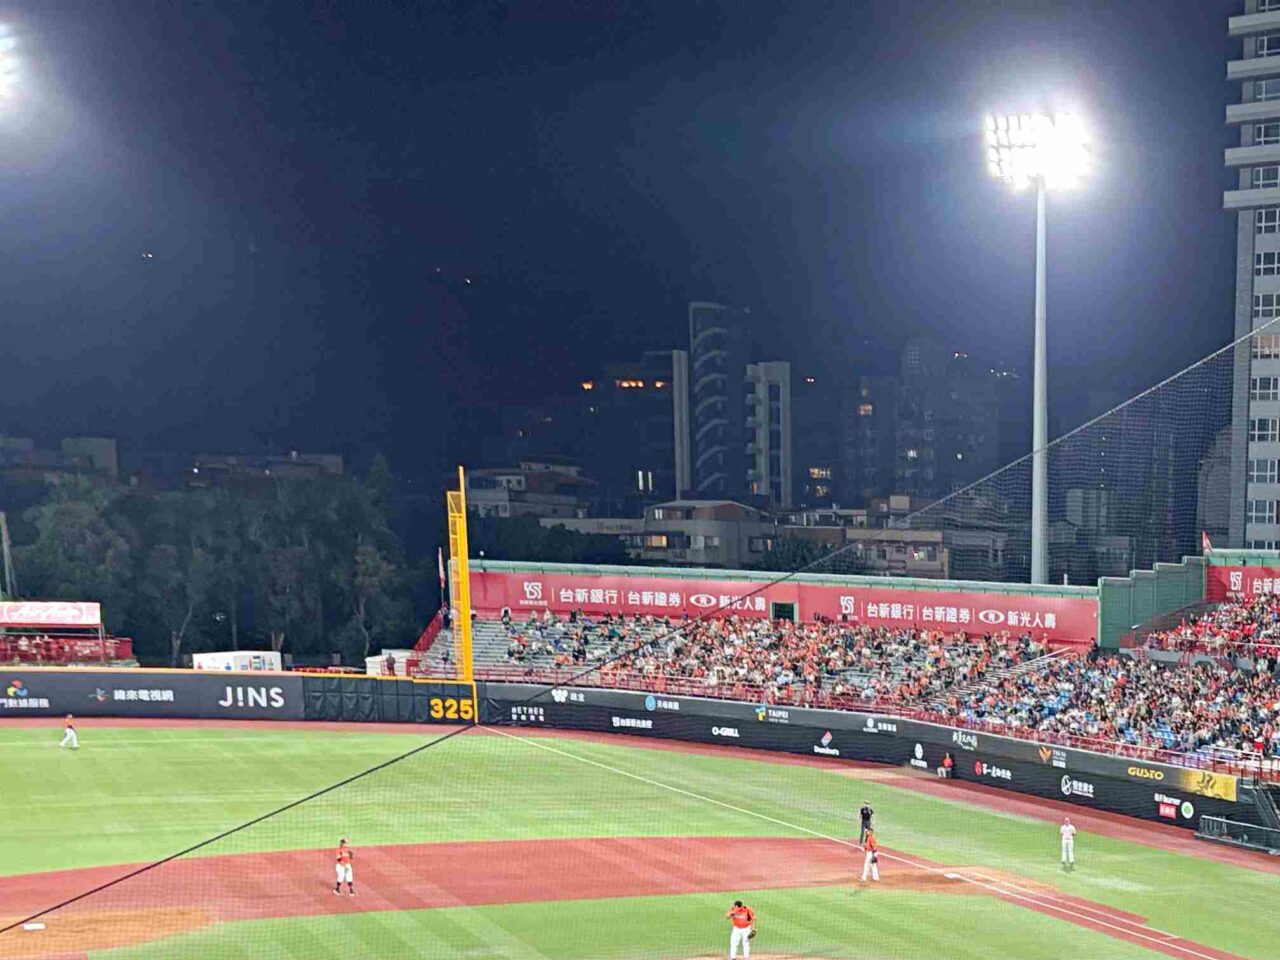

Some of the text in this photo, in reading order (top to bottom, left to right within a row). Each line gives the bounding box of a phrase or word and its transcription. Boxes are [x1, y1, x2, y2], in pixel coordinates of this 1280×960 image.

[559, 588, 618, 604] 台新銀行
[627, 591, 682, 608] 台新證券
[718, 594, 766, 611] 新光人壽
[866, 603, 914, 621] 台新銀行
[922, 606, 970, 624] 台新證券
[1007, 611, 1057, 629] 新光人壽
[430, 698, 473, 720] 325
[768, 709, 789, 719] TAIPEI
[1127, 766, 1165, 780] GUSTO
